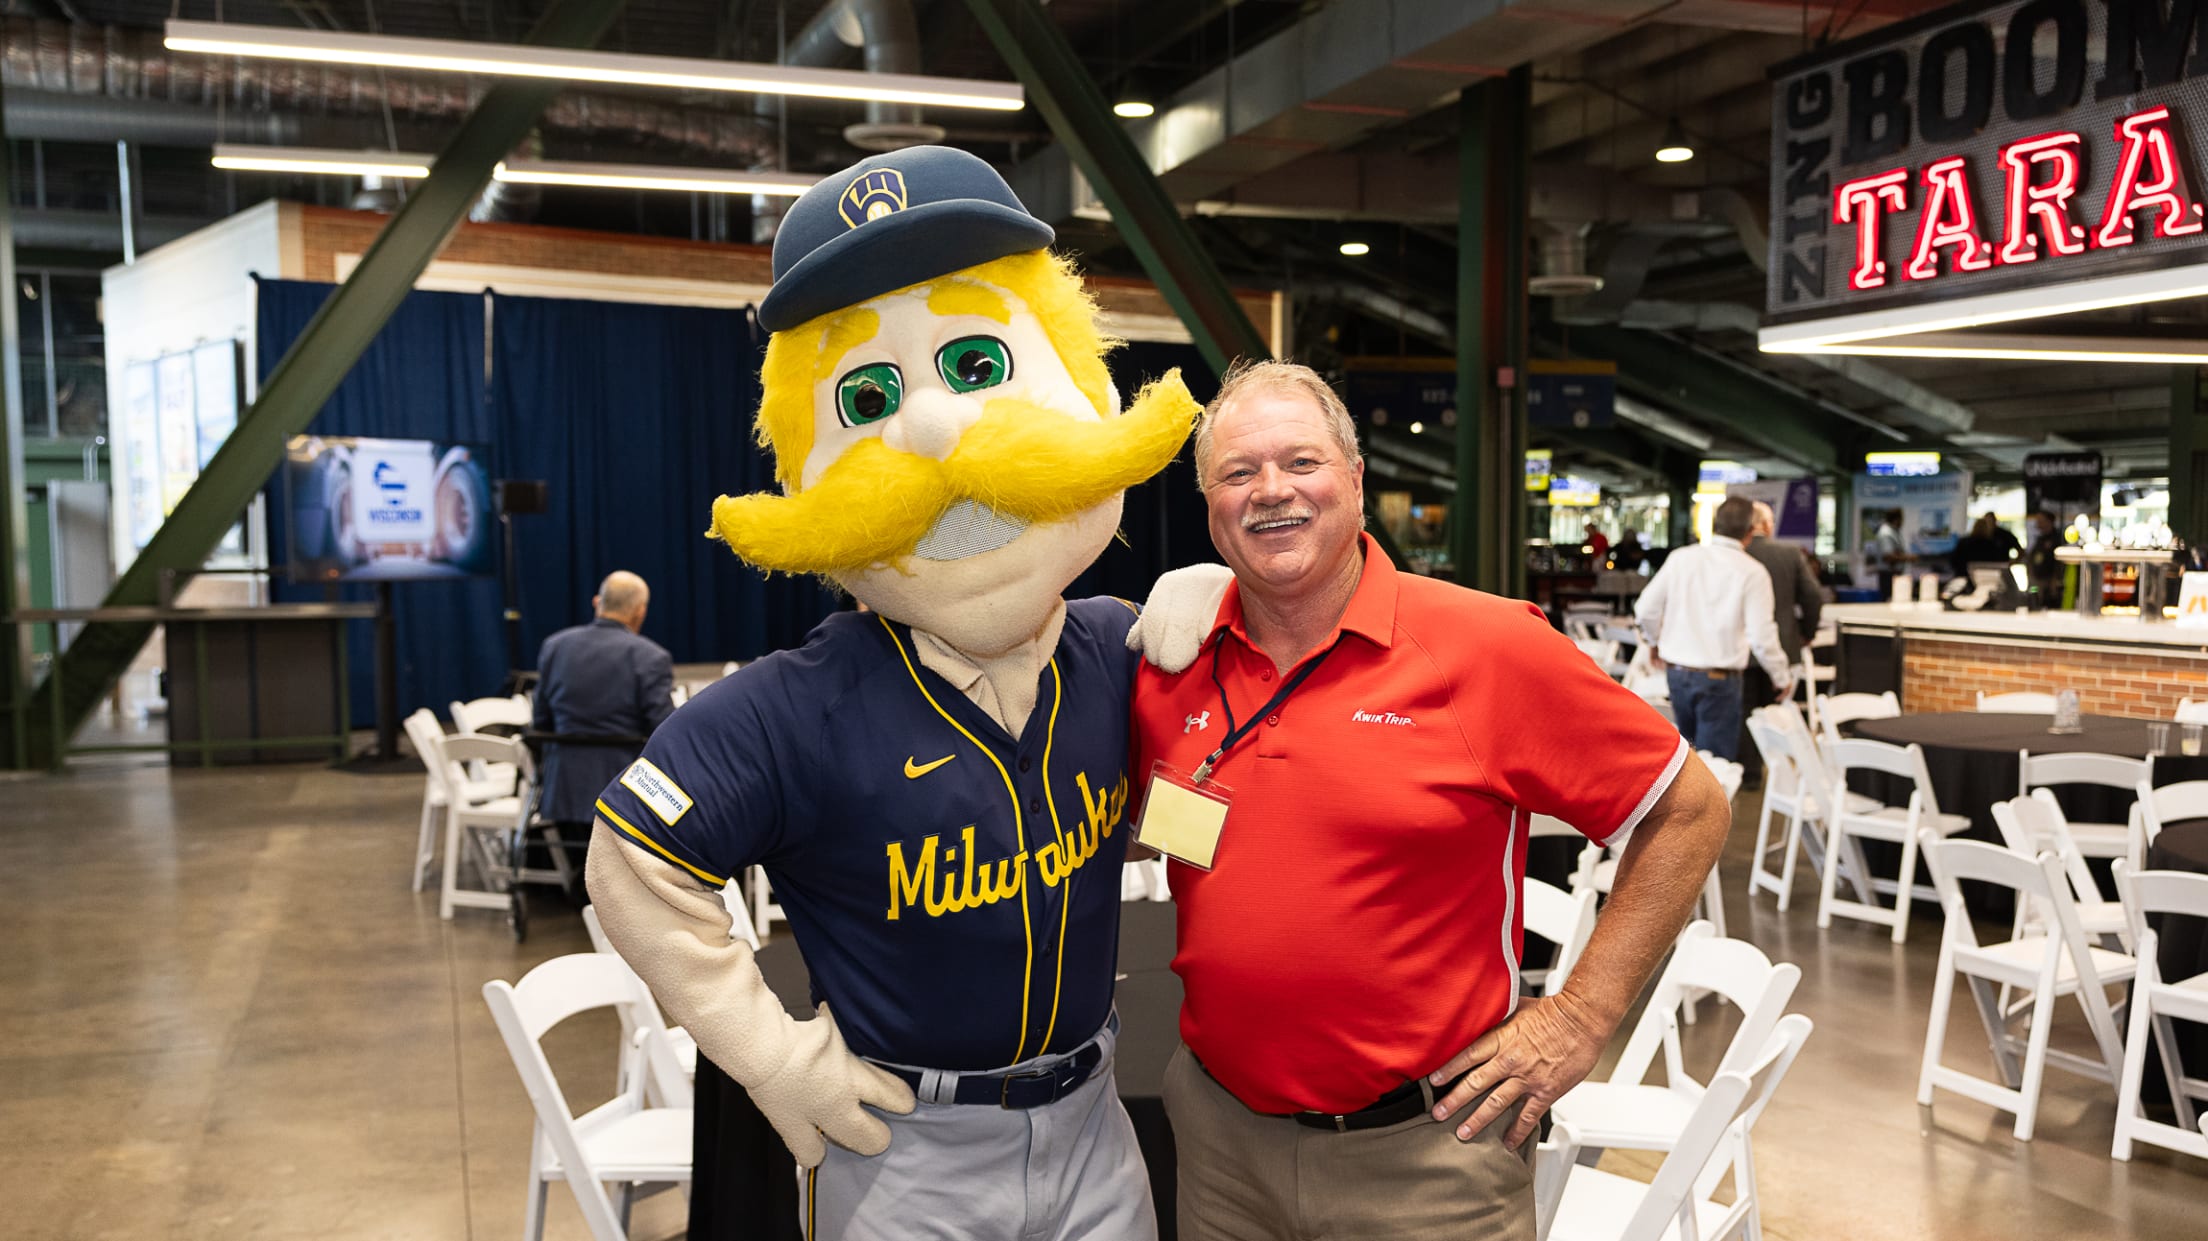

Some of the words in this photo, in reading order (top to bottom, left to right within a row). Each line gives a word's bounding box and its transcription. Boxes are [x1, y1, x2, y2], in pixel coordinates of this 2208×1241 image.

[1784, 71, 1831, 302] ZING
[1834, 105, 2204, 290] TARA
[636, 777, 659, 798] Mutual
[643, 771, 684, 812] Northwestern
